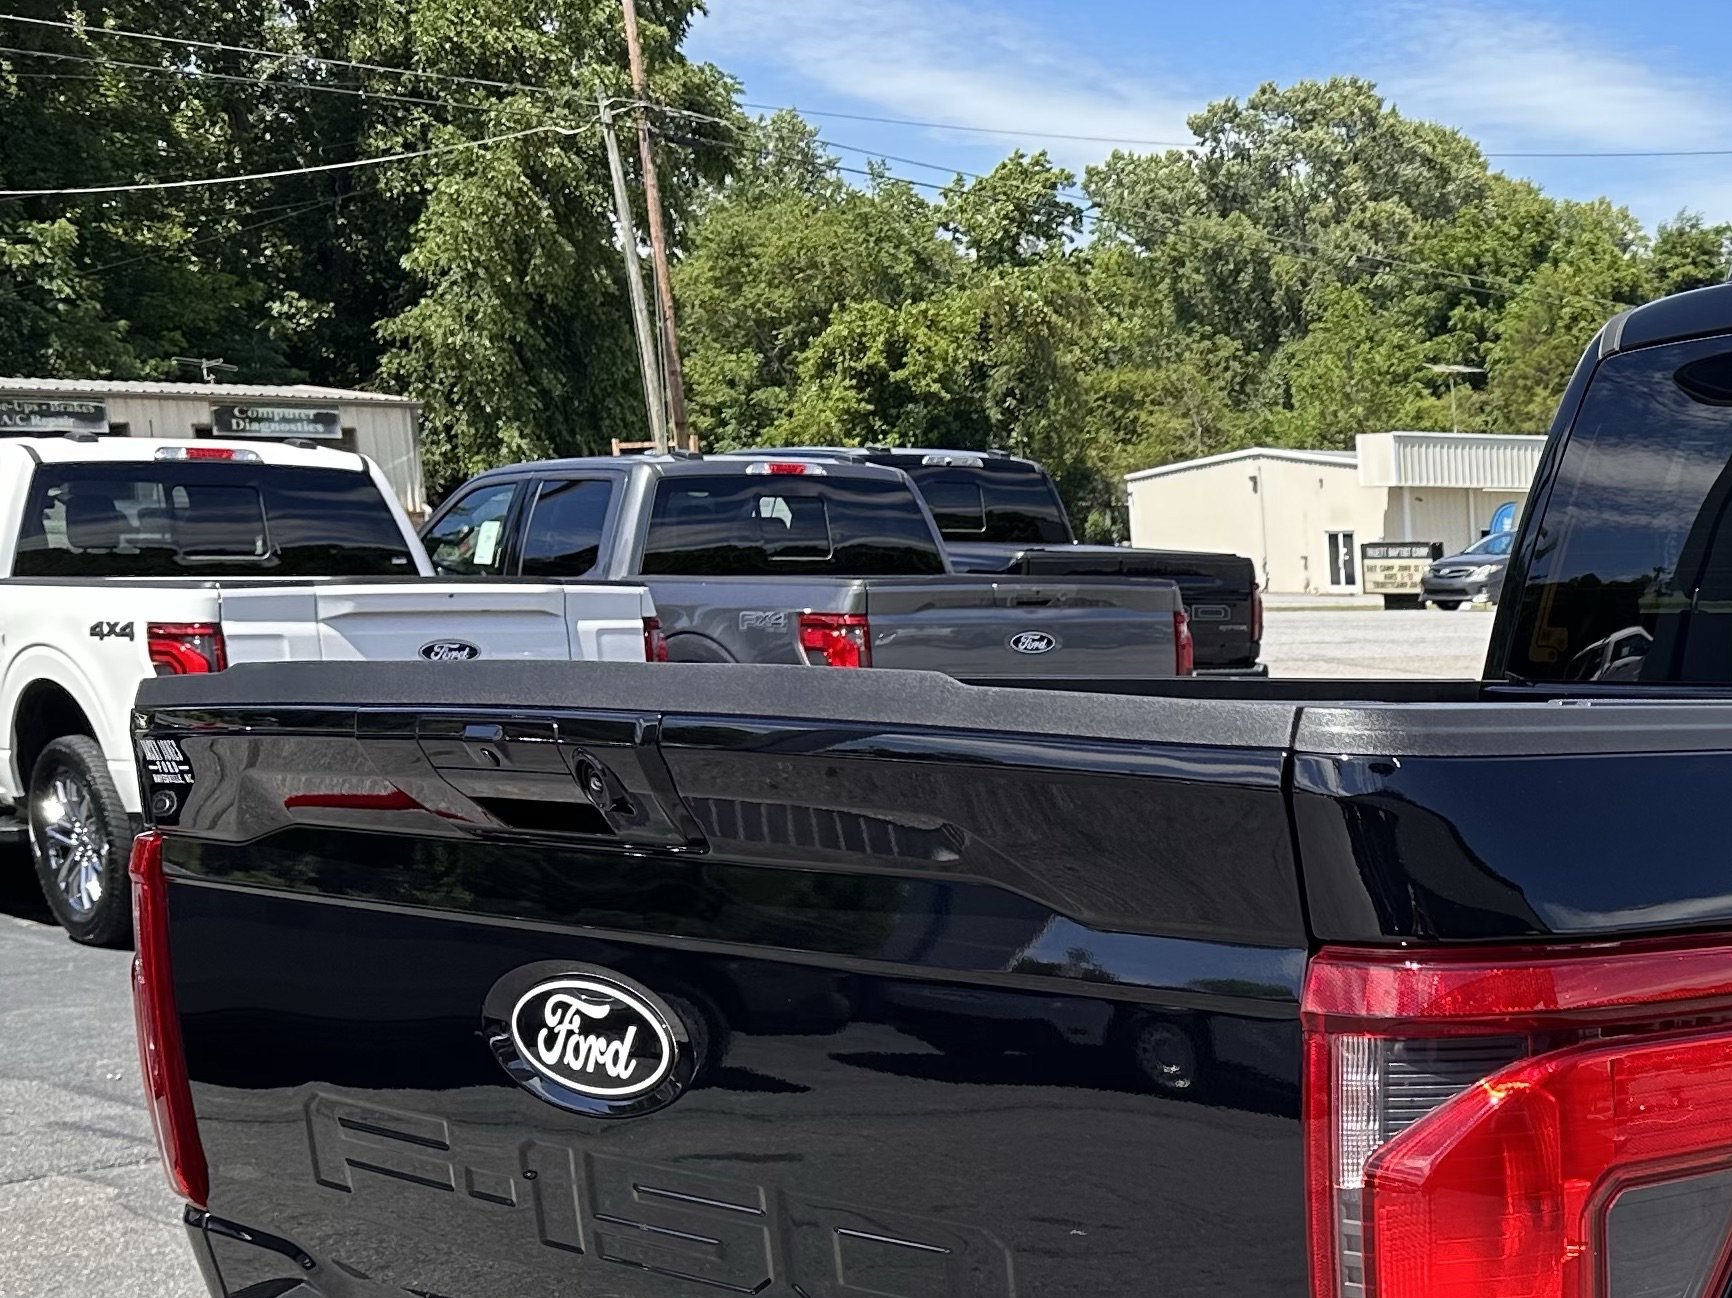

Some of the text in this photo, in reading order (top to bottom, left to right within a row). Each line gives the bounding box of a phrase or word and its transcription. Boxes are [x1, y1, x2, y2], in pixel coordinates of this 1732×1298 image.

[233, 406, 314, 420] Computer
[231, 419, 325, 433] Diagnostics
[536, 992, 638, 1081] Ford
